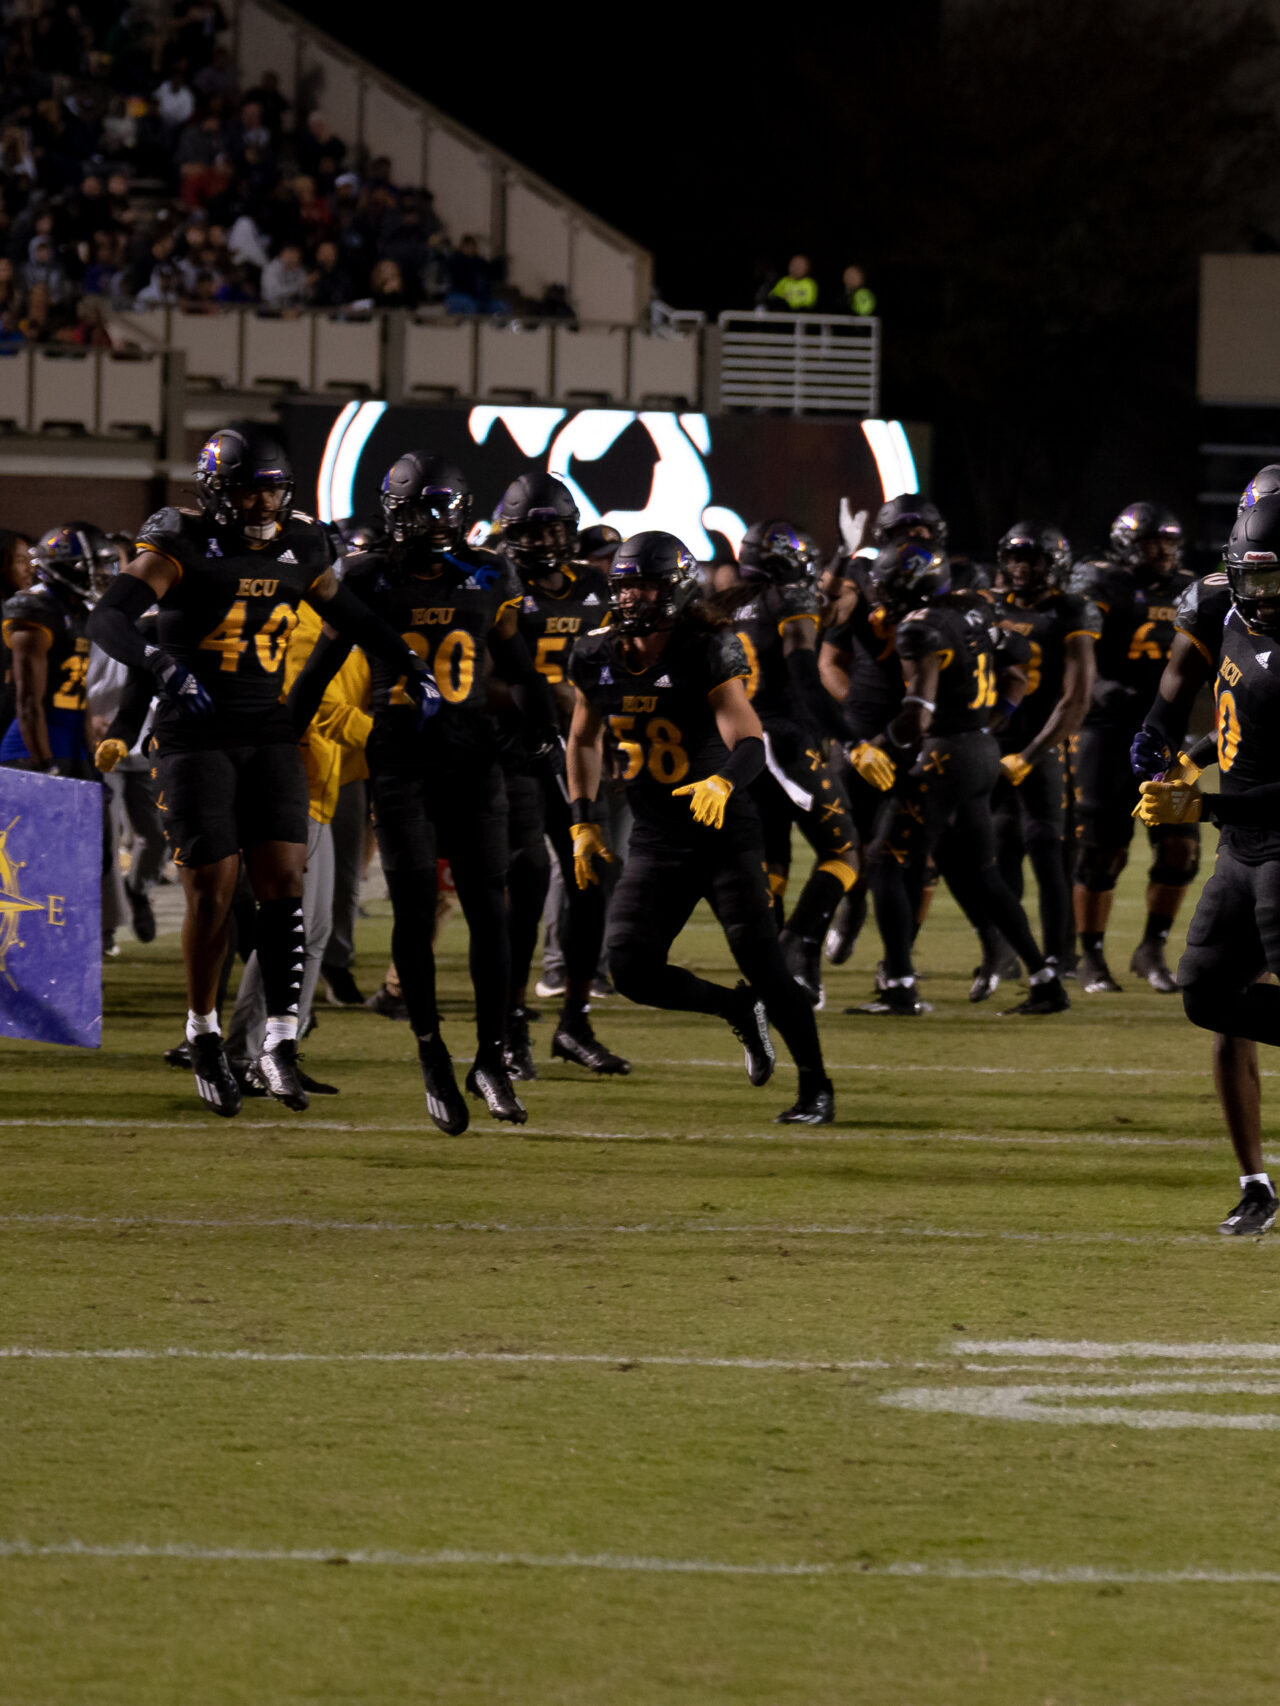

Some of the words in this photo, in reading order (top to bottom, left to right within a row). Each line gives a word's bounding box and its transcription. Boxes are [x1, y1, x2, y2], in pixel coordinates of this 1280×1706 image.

[235, 578, 279, 597] ECU
[410, 607, 456, 626] ECU
[545, 617, 582, 634] ECU
[199, 600, 298, 674] 40
[1220, 655, 1243, 687] ECU
[621, 696, 659, 713] ECU
[608, 714, 690, 784] 58
[47, 894, 66, 926] E
